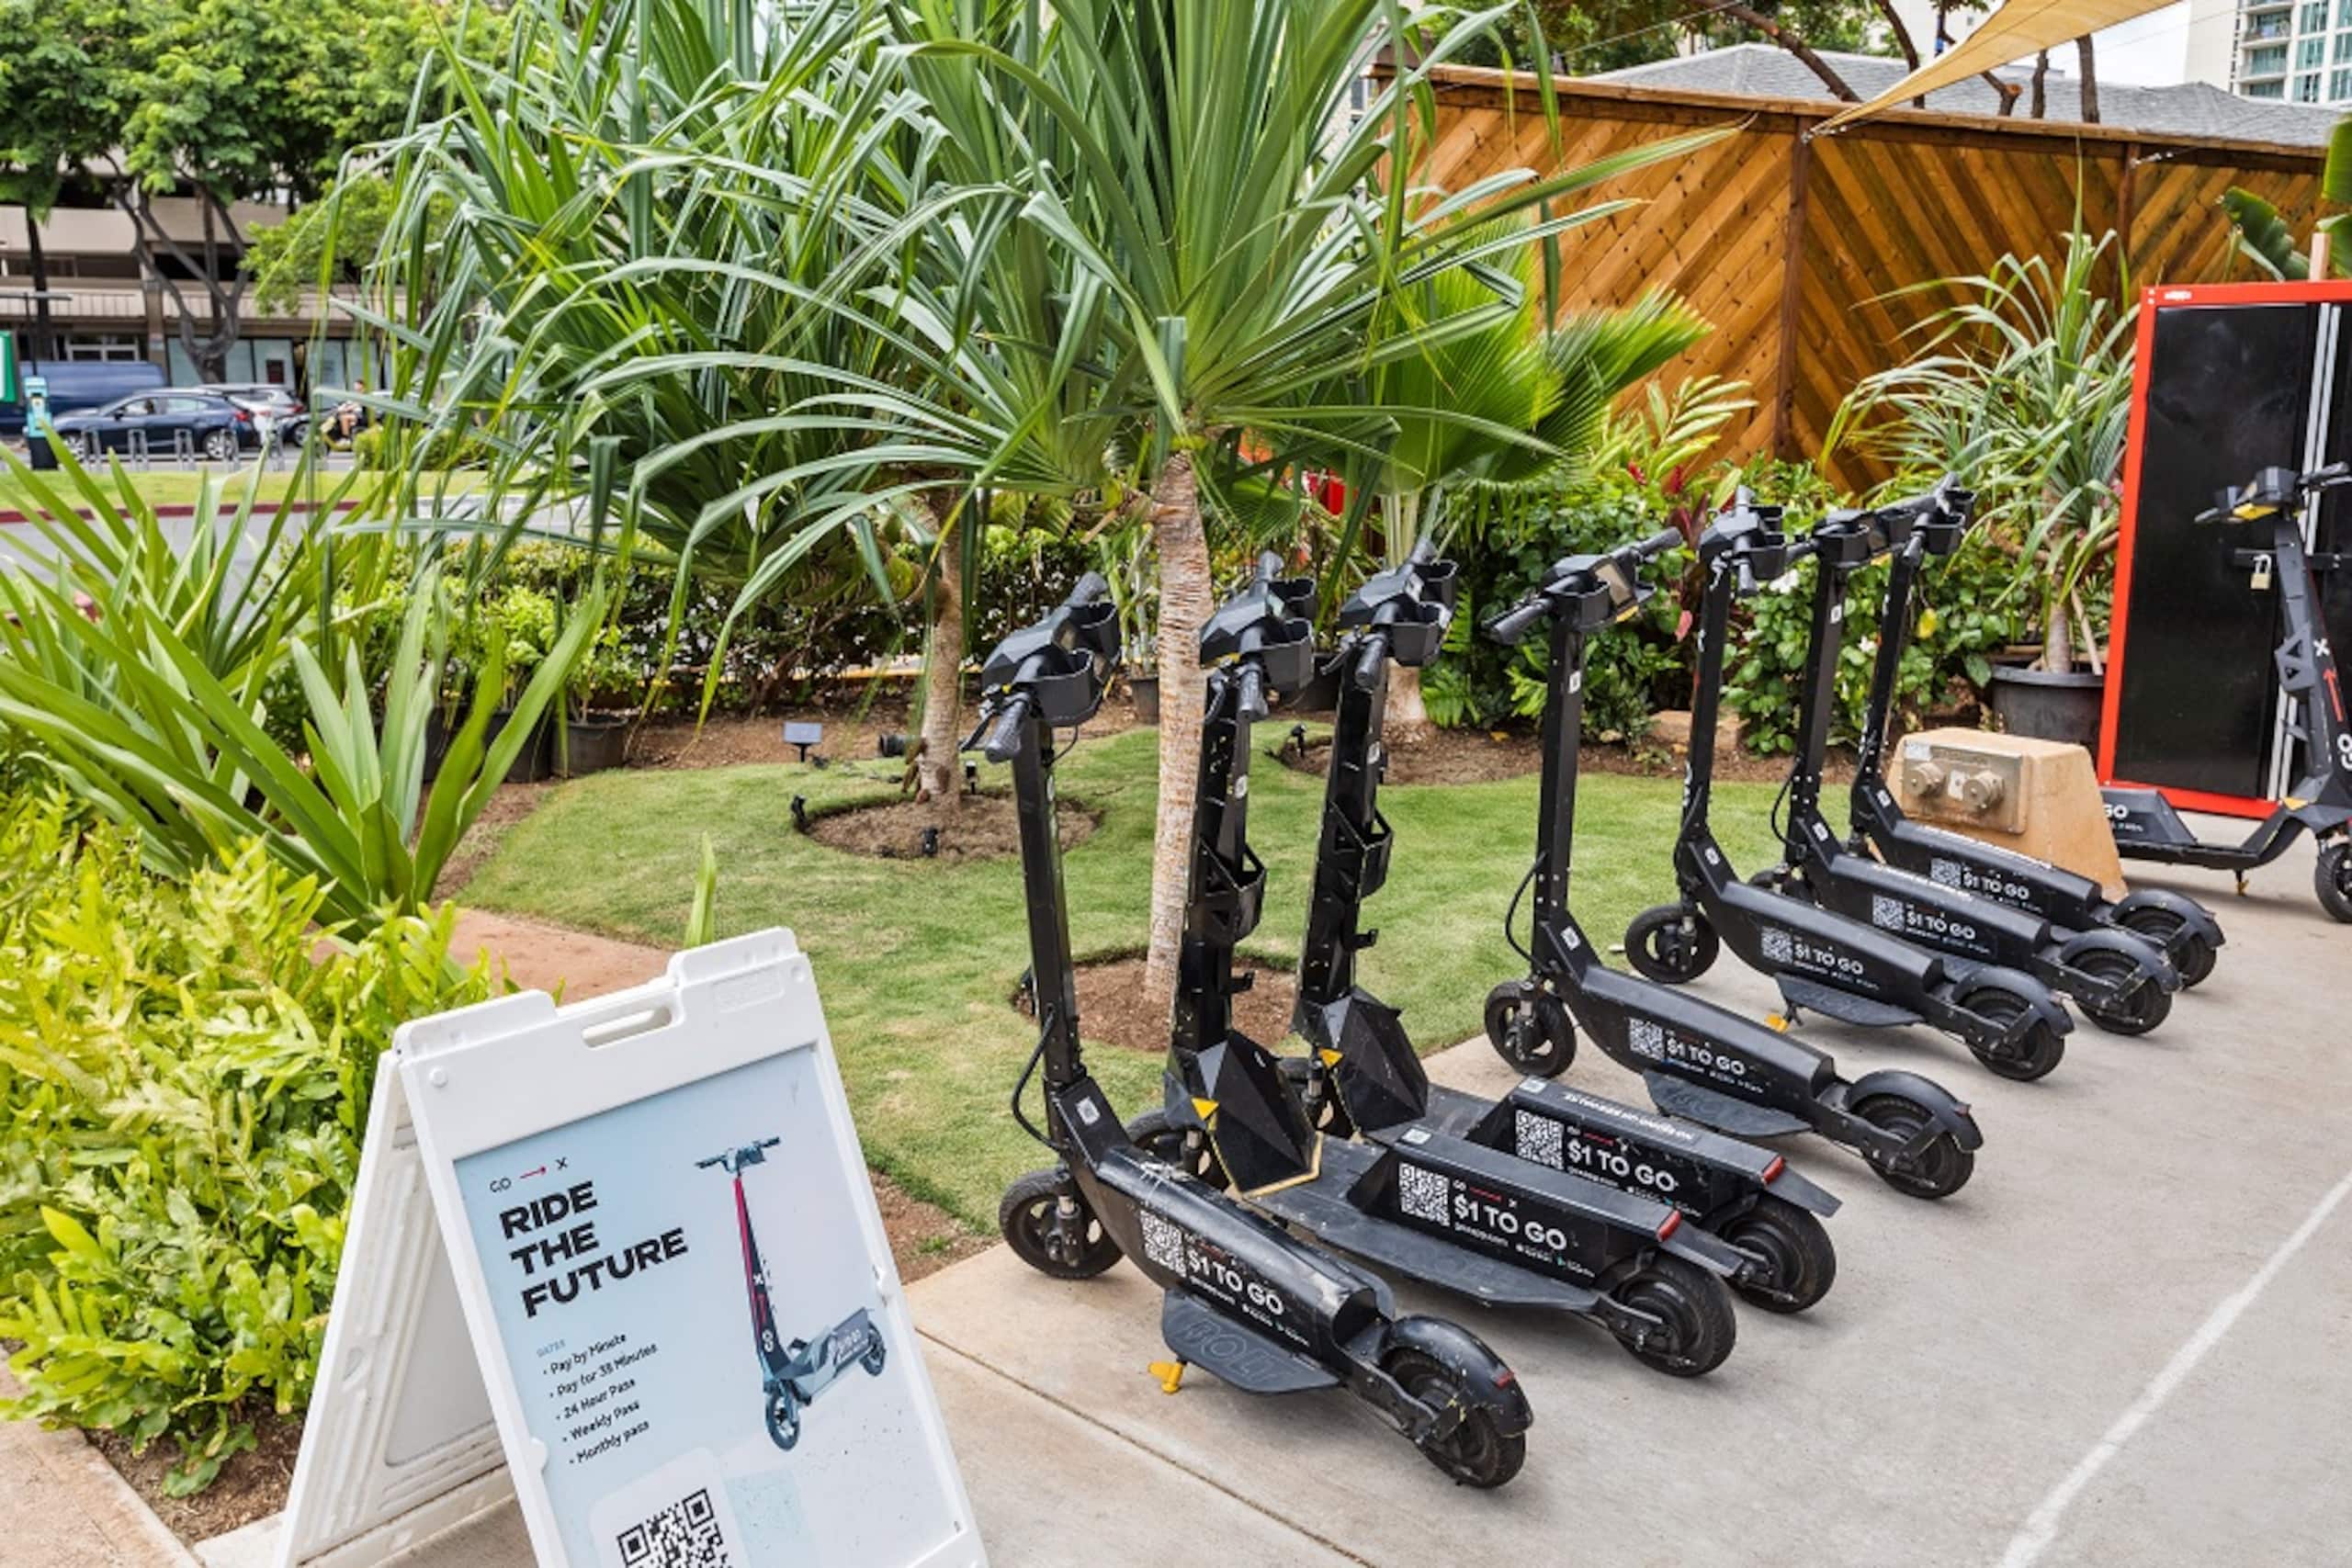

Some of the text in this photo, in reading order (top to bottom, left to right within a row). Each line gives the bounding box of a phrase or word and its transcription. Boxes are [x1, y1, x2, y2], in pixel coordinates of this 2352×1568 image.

[1813, 948, 1836, 967] TO
[1838, 957, 1864, 976] GO
[1688, 1044, 1713, 1066] TO
[1715, 1055, 1746, 1076] GO
[490, 1177, 512, 1193] GO
[1566, 1138, 1592, 1167] $1
[1597, 1148, 1631, 1178] TO
[1634, 1163, 1676, 1192] GO
[499, 1180, 598, 1240] RIDE
[1453, 1193, 1480, 1223] $1
[1483, 1205, 1519, 1234] TO
[1523, 1221, 1567, 1251] GO
[509, 1220, 601, 1275] THE
[521, 1227, 689, 1318] FUTURE
[1187, 1248, 1210, 1276] $1
[1212, 1260, 1243, 1292] TO
[1247, 1280, 1284, 1315] GO
[550, 1334, 627, 1374] Pay by Minute
[581, 1391, 608, 1411] Hour
[608, 1379, 636, 1397] Pass
[570, 1413, 612, 1440] Weekly
[576, 1434, 622, 1463] Monthly
